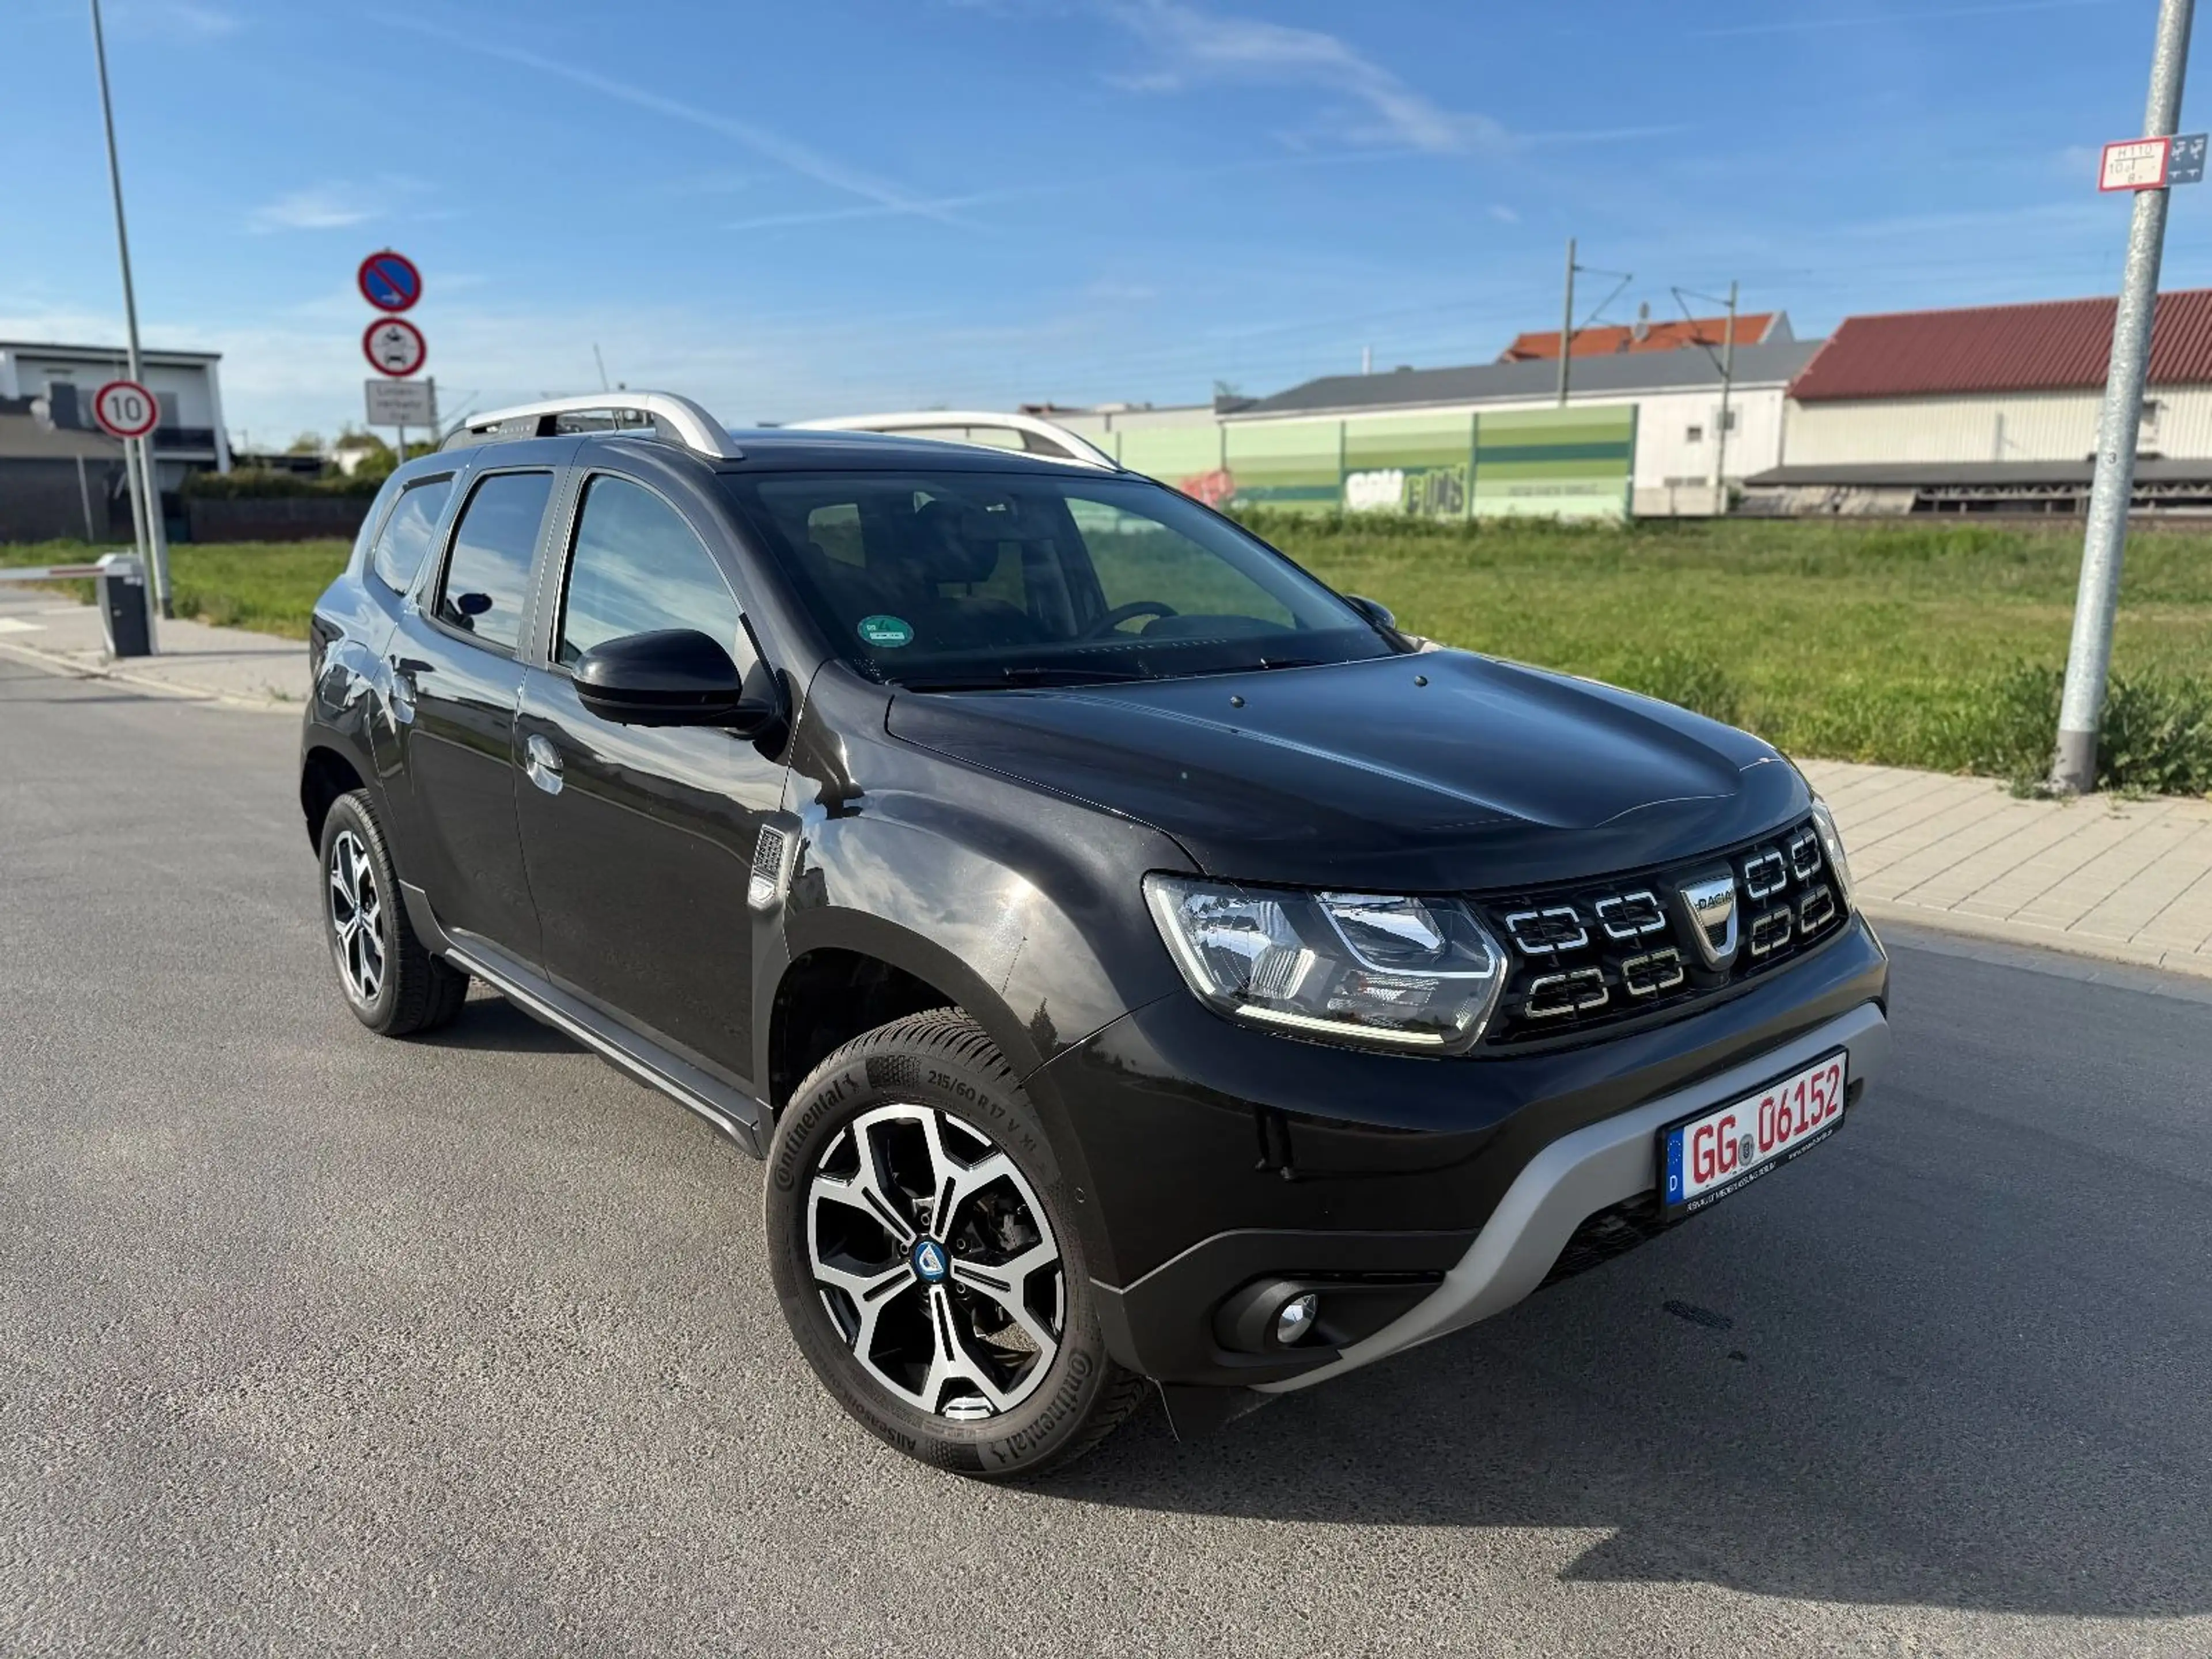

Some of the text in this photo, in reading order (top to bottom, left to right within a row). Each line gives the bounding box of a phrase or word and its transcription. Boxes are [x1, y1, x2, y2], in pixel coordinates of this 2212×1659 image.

[111, 395, 142, 422] 10
[1698, 890, 1732, 909] DACIA
[927, 1070, 976, 1101] 215/60
[979, 1093, 990, 1109] R
[990, 1104, 1006, 1119] 17
[775, 1080, 846, 1191] Continental
[1692, 1114, 1737, 1184] GG
[1758, 1064, 1840, 1153] 06152
[1669, 1175, 1677, 1192] D
[1005, 1348, 1093, 1460] Continental
